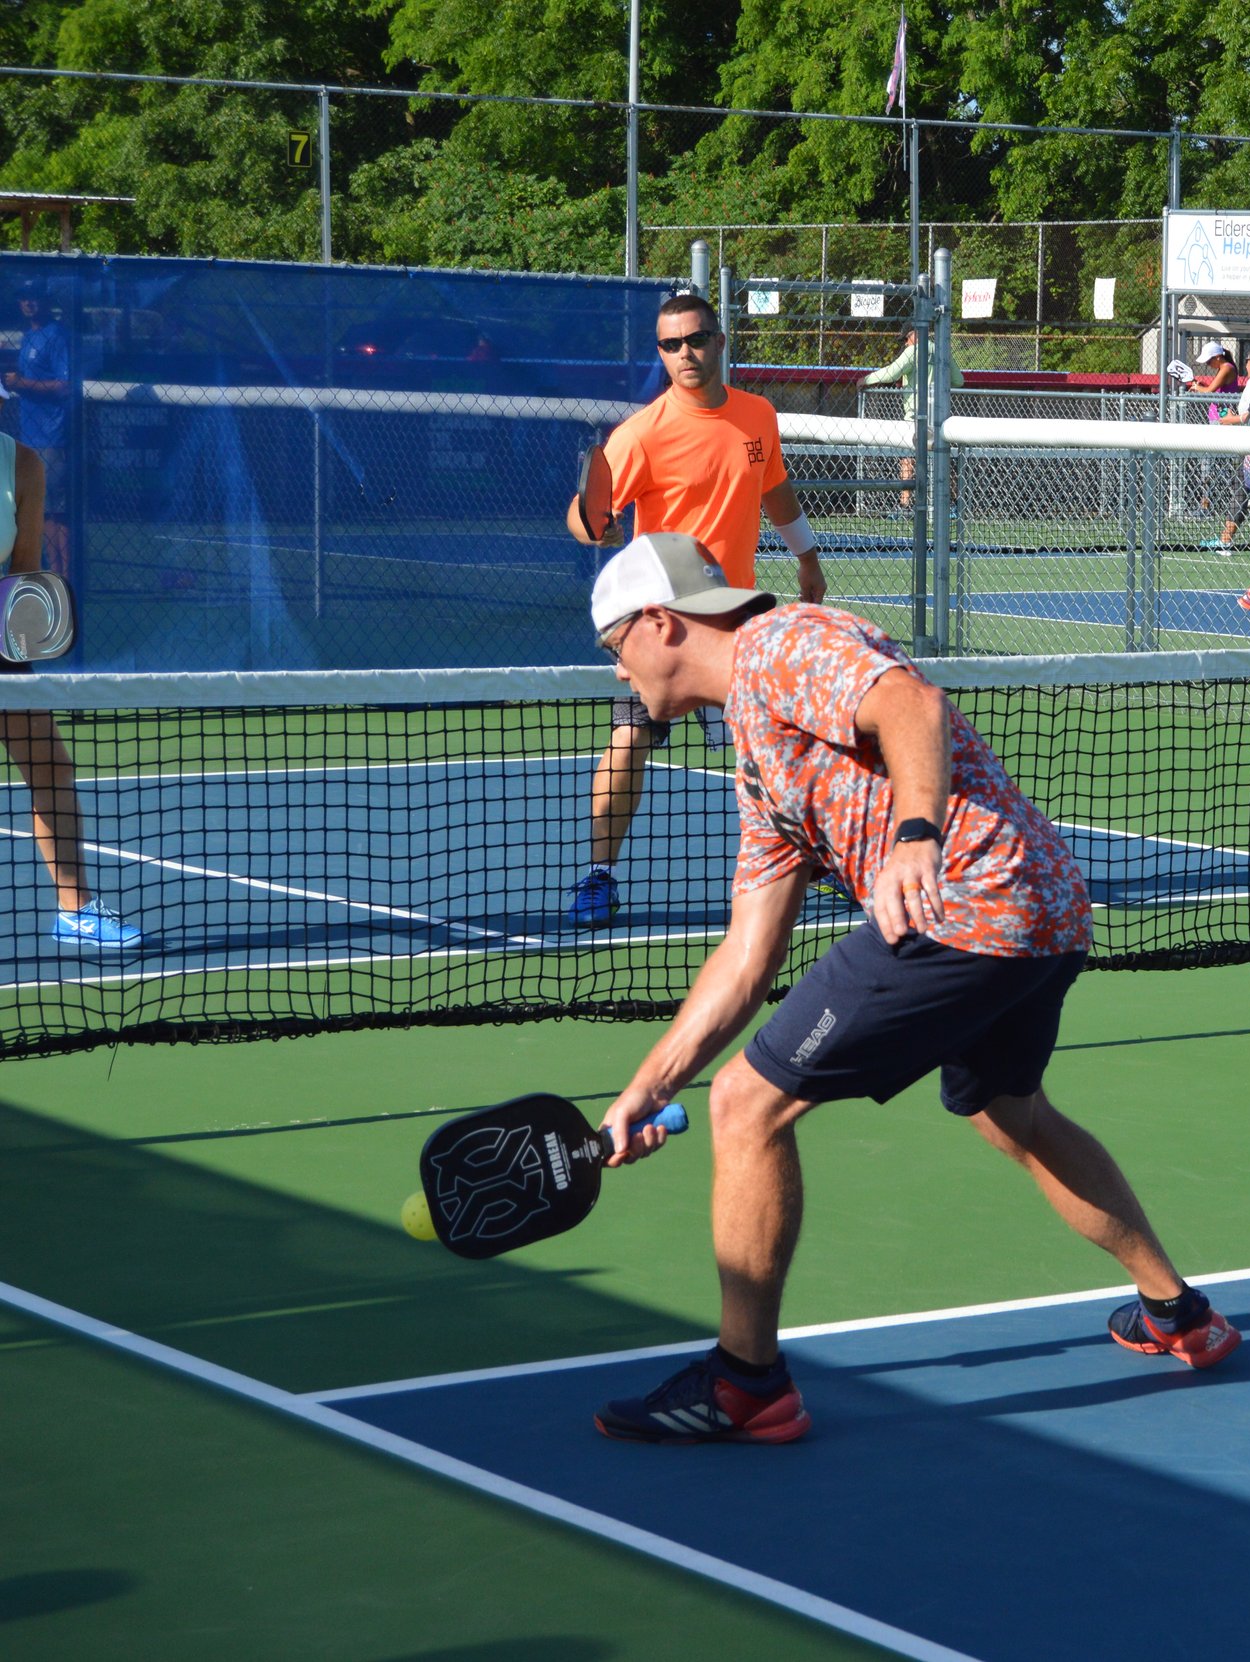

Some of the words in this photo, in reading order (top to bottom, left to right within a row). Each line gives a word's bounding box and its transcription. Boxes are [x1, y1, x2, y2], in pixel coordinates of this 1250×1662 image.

[290, 134, 308, 163] 7
[854, 294, 881, 309] Bicycle
[790, 1013, 837, 1068] HEAD
[543, 1131, 567, 1191] OUTBREAK
